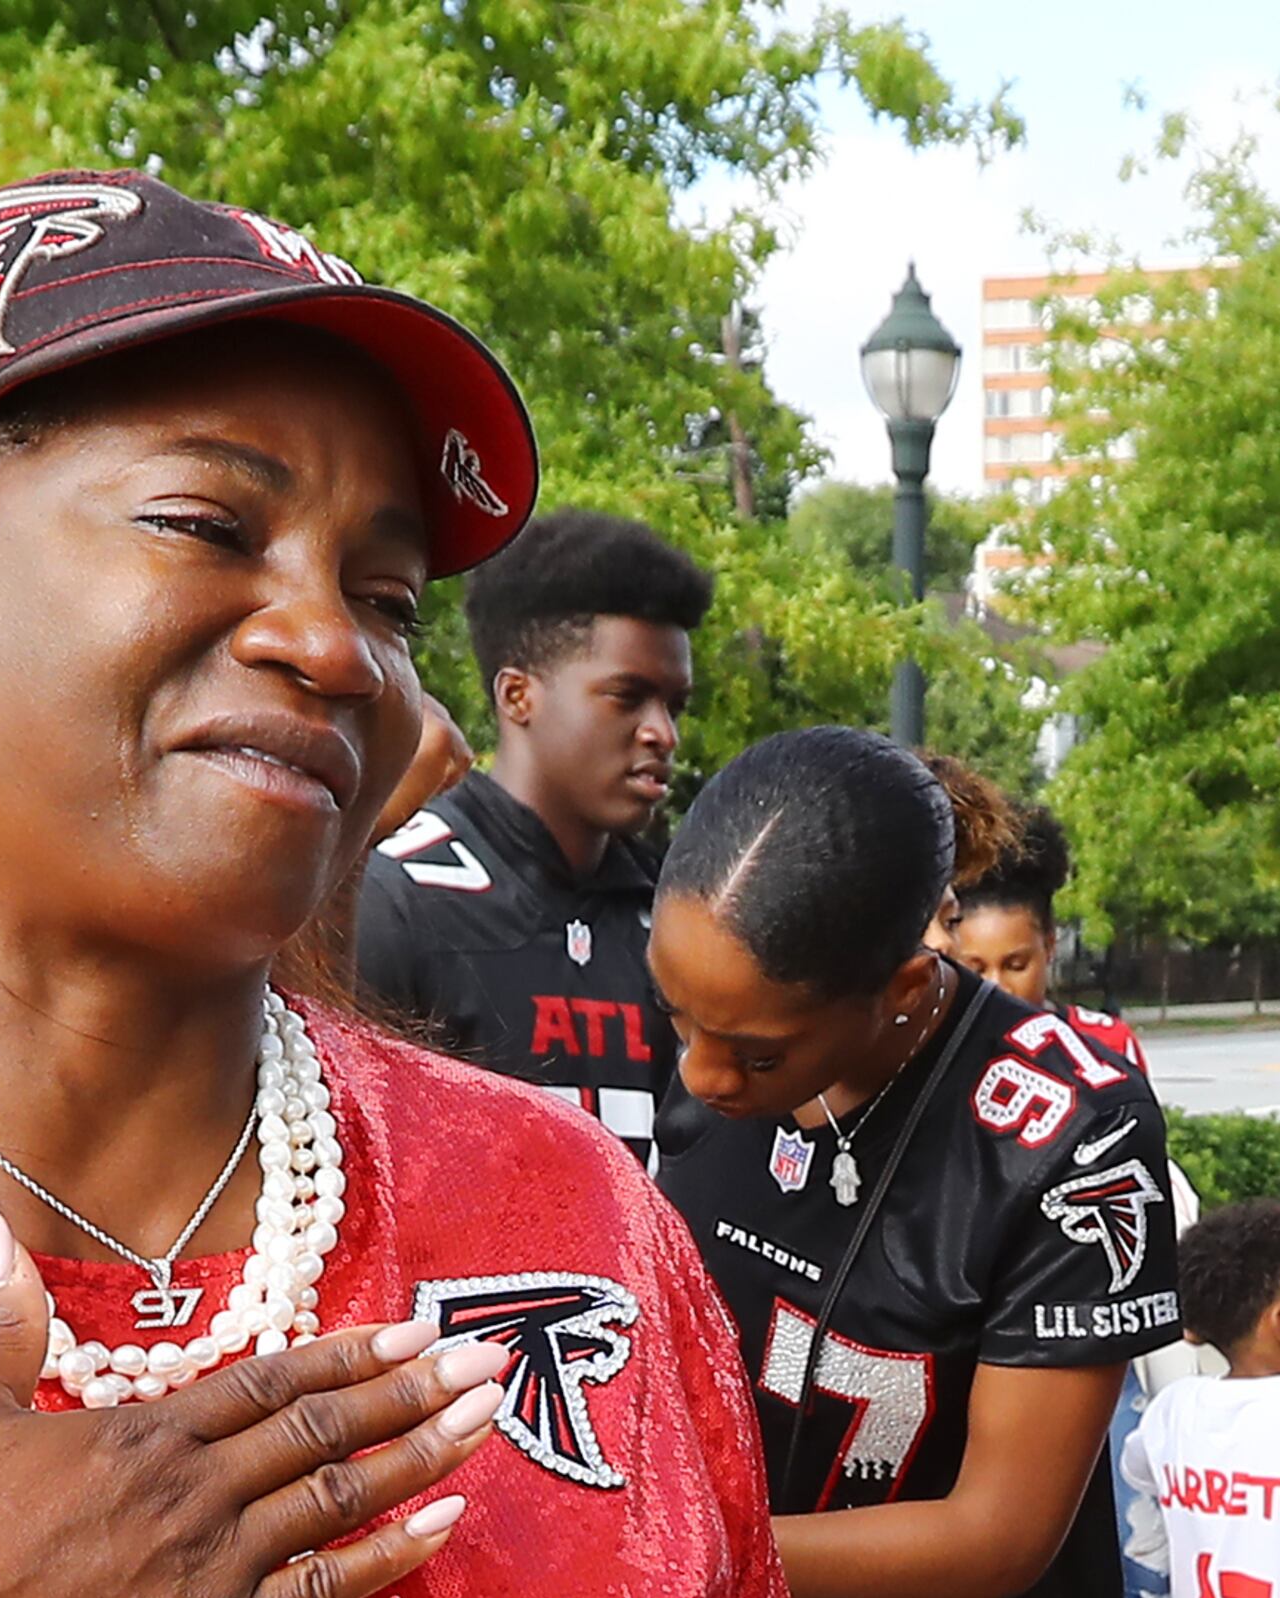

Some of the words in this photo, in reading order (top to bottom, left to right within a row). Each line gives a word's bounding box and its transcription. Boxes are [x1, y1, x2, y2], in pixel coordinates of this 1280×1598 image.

[531, 995, 654, 1062] ATL
[970, 1010, 1128, 1149] 97
[716, 1220, 822, 1282] FALCONS
[129, 1287, 205, 1329] 97
[1034, 1304, 1087, 1338] LIL
